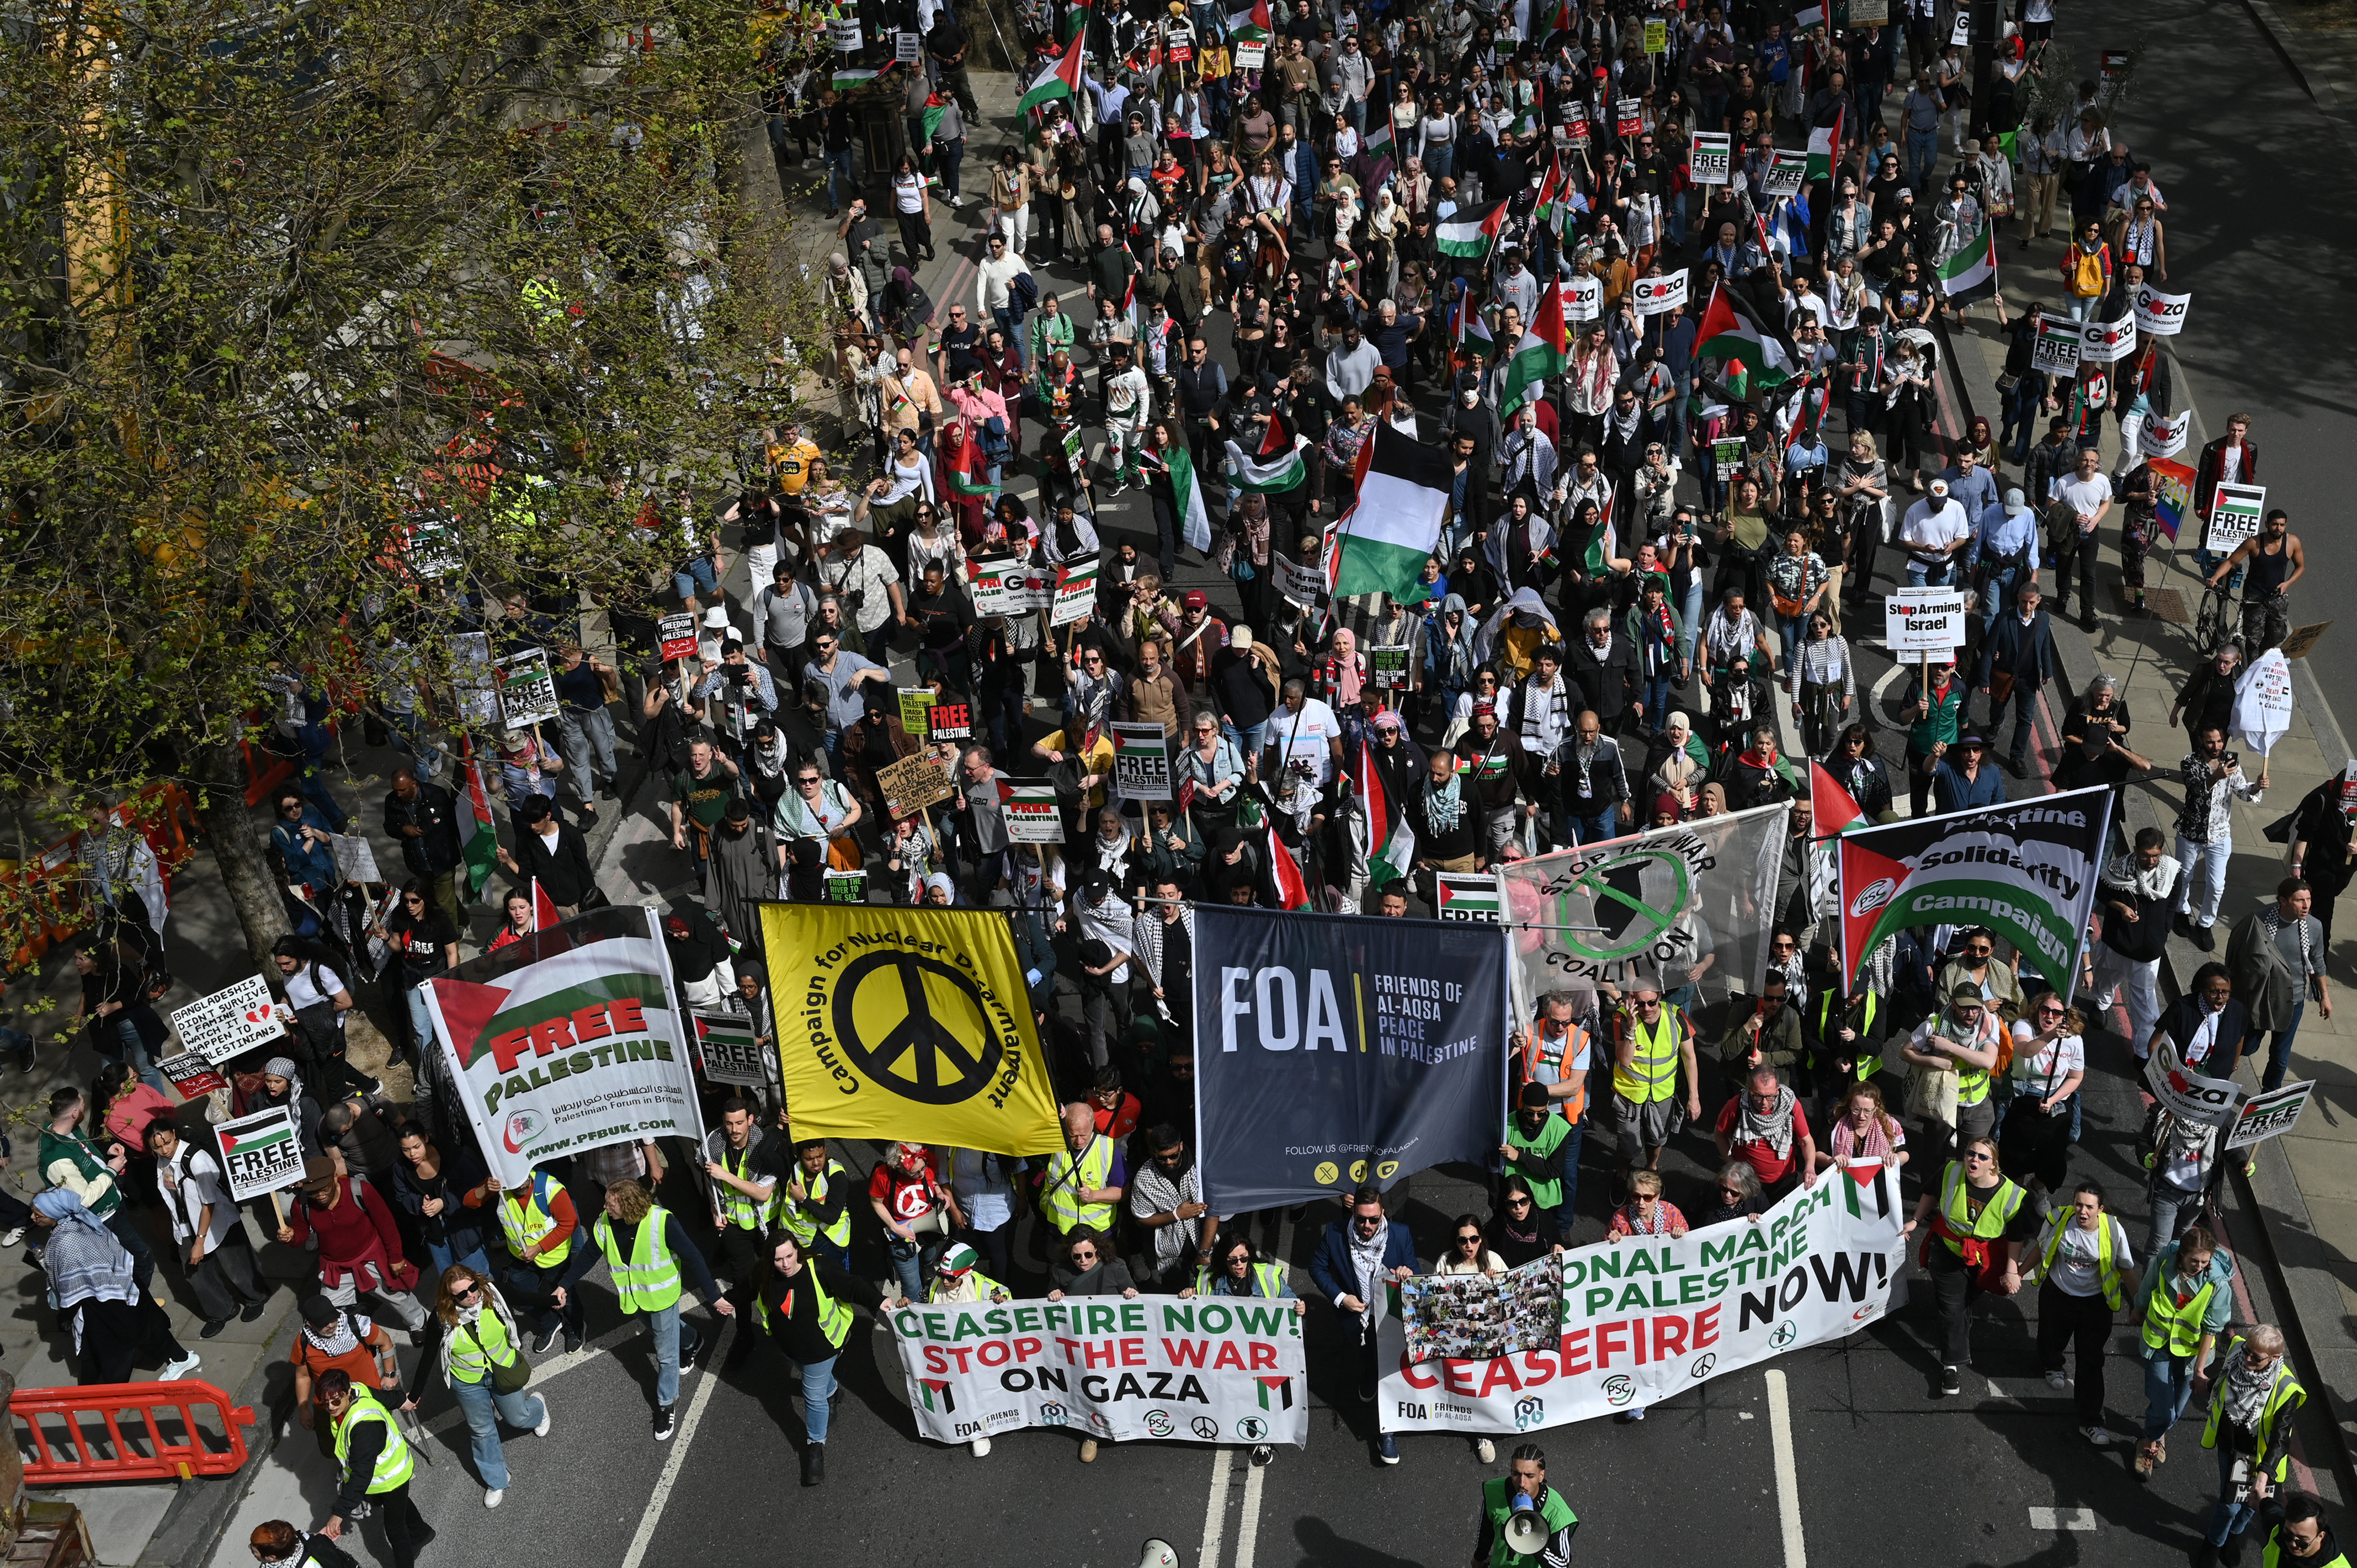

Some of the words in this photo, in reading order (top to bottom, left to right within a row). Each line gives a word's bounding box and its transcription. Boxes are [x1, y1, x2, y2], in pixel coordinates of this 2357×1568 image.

[834, 32, 856, 41] Israel
[1562, 105, 1582, 115] FREEDOM
[1617, 111, 1640, 121] PALESTINE
[1619, 103, 1639, 112] FREEDOM
[1563, 114, 1585, 124] PALESTINE
[1692, 154, 1727, 169] FREE
[1692, 166, 1727, 176] PALESTINE
[1765, 179, 1798, 187] PALESTINE
[1767, 169, 1803, 181] FREE
[1659, 291, 1684, 303] massacre
[2035, 351, 2075, 366] PALESTINE
[2036, 338, 2078, 359] FREE
[2148, 438, 2158, 449] the
[2212, 511, 2259, 533] FREE
[1055, 587, 1094, 606] PALESTINE
[1061, 577, 1092, 596] FREE
[1920, 602, 1961, 615] Arming
[662, 619, 691, 632] FREEDOM
[1905, 616, 1946, 631] Israel
[662, 629, 694, 642] PALESTINE
[902, 700, 930, 709] PALESTINE
[930, 704, 970, 729] FREE
[2087, 715, 2112, 724] PEACE
[932, 727, 971, 740] PALESTINE
[877, 765, 899, 782] HOW
[902, 752, 928, 769] MANY
[897, 764, 922, 780] MORE
[916, 765, 942, 781] KILLED
[1115, 754, 1167, 775] FREE
[910, 778, 951, 797] OPPRESSORS
[1118, 773, 1168, 784] PALESTINE
[884, 782, 916, 802] BECAUSE
[1005, 814, 1059, 822] PALESTINE
[1009, 802, 1052, 814] FREE
[1617, 837, 1673, 856] THE
[1668, 834, 1717, 876] WAR
[829, 879, 847, 887] FROM
[849, 877, 861, 886] THE
[830, 886, 849, 895] RIVER
[850, 885, 859, 893] TO
[830, 893, 843, 903] THE
[844, 893, 857, 903] SEA
[1858, 886, 1886, 912] PSC
[847, 930, 948, 955] Nuclear
[1912, 894, 2069, 972] Campaign
[814, 942, 849, 972] for
[1545, 926, 1695, 985] COALITION
[1374, 974, 1440, 1002] FRIENDS
[1445, 981, 1463, 1003] OF
[173, 979, 256, 1022] BANGLADESHIS
[177, 1009, 214, 1031] DIDN'T
[219, 985, 268, 1013] SURVIVE
[1221, 965, 1348, 1053] FOA
[1377, 995, 1441, 1022] AL-AQSA
[182, 1031, 192, 1039] A
[194, 1010, 236, 1032] FAMINE
[240, 1001, 257, 1012] TO
[236, 1024, 251, 1036] TO
[1378, 1015, 1425, 1041] PEACE
[186, 1026, 222, 1046] WATCH
[225, 1017, 238, 1030] IT
[489, 997, 648, 1075] FREE
[801, 975, 860, 1095] Campaign
[203, 1025, 276, 1061] ALESTINIANS
[700, 1041, 760, 1065] FREE
[1380, 1036, 1396, 1057] IN
[1401, 1035, 1477, 1065] PALESTINE
[164, 1057, 204, 1073] FREEDOM
[169, 1065, 213, 1082] PALESTINE
[704, 1057, 761, 1074] PALESTINE
[483, 1039, 675, 1117] PALESTINE
[554, 1104, 608, 1126] Palestinian
[610, 1098, 641, 1112] Forum
[643, 1097, 652, 1107] in
[655, 1095, 685, 1107] Britain
[2171, 1094, 2221, 1117] massacre
[217, 1121, 239, 1131] Palestine
[239, 1115, 262, 1127] Solidarity
[262, 1108, 286, 1120] Campaign
[2231, 1114, 2299, 1140] PALESTINE
[2234, 1104, 2302, 1133] FREE
[226, 1138, 298, 1176] FREE
[1285, 1144, 1323, 1156] FOLLOW
[1325, 1144, 1336, 1153] US
[231, 1156, 301, 1185] PALESTINE
[235, 1182, 247, 1191] END
[247, 1177, 269, 1188] ISRAELI
[269, 1164, 302, 1181] OCCUPATION
[1699, 1183, 1832, 1269] MARCH
[1586, 1223, 1808, 1319] PALESTINE
[1739, 1251, 1890, 1333] NOW!
[893, 1303, 1147, 1342] CEASEFIRE
[1162, 1303, 1300, 1338] NOW!
[922, 1336, 1042, 1375] STOP
[1054, 1336, 1148, 1371] THE
[1159, 1337, 1279, 1372] WAR
[999, 1367, 1069, 1394] ON
[1080, 1371, 1210, 1405] GAZA
[1607, 1382, 1631, 1396] PSC
[1398, 1401, 1427, 1420] FOA
[1435, 1402, 1472, 1415] FRIENDS
[1445, 1412, 1472, 1422] AL-AQSA
[954, 1420, 982, 1437] FOA
[986, 1409, 1019, 1424] FRIENDS
[988, 1421, 995, 1430] OF
[996, 1417, 1021, 1427] AL-AQSA
[1148, 1418, 1170, 1428] PSC
